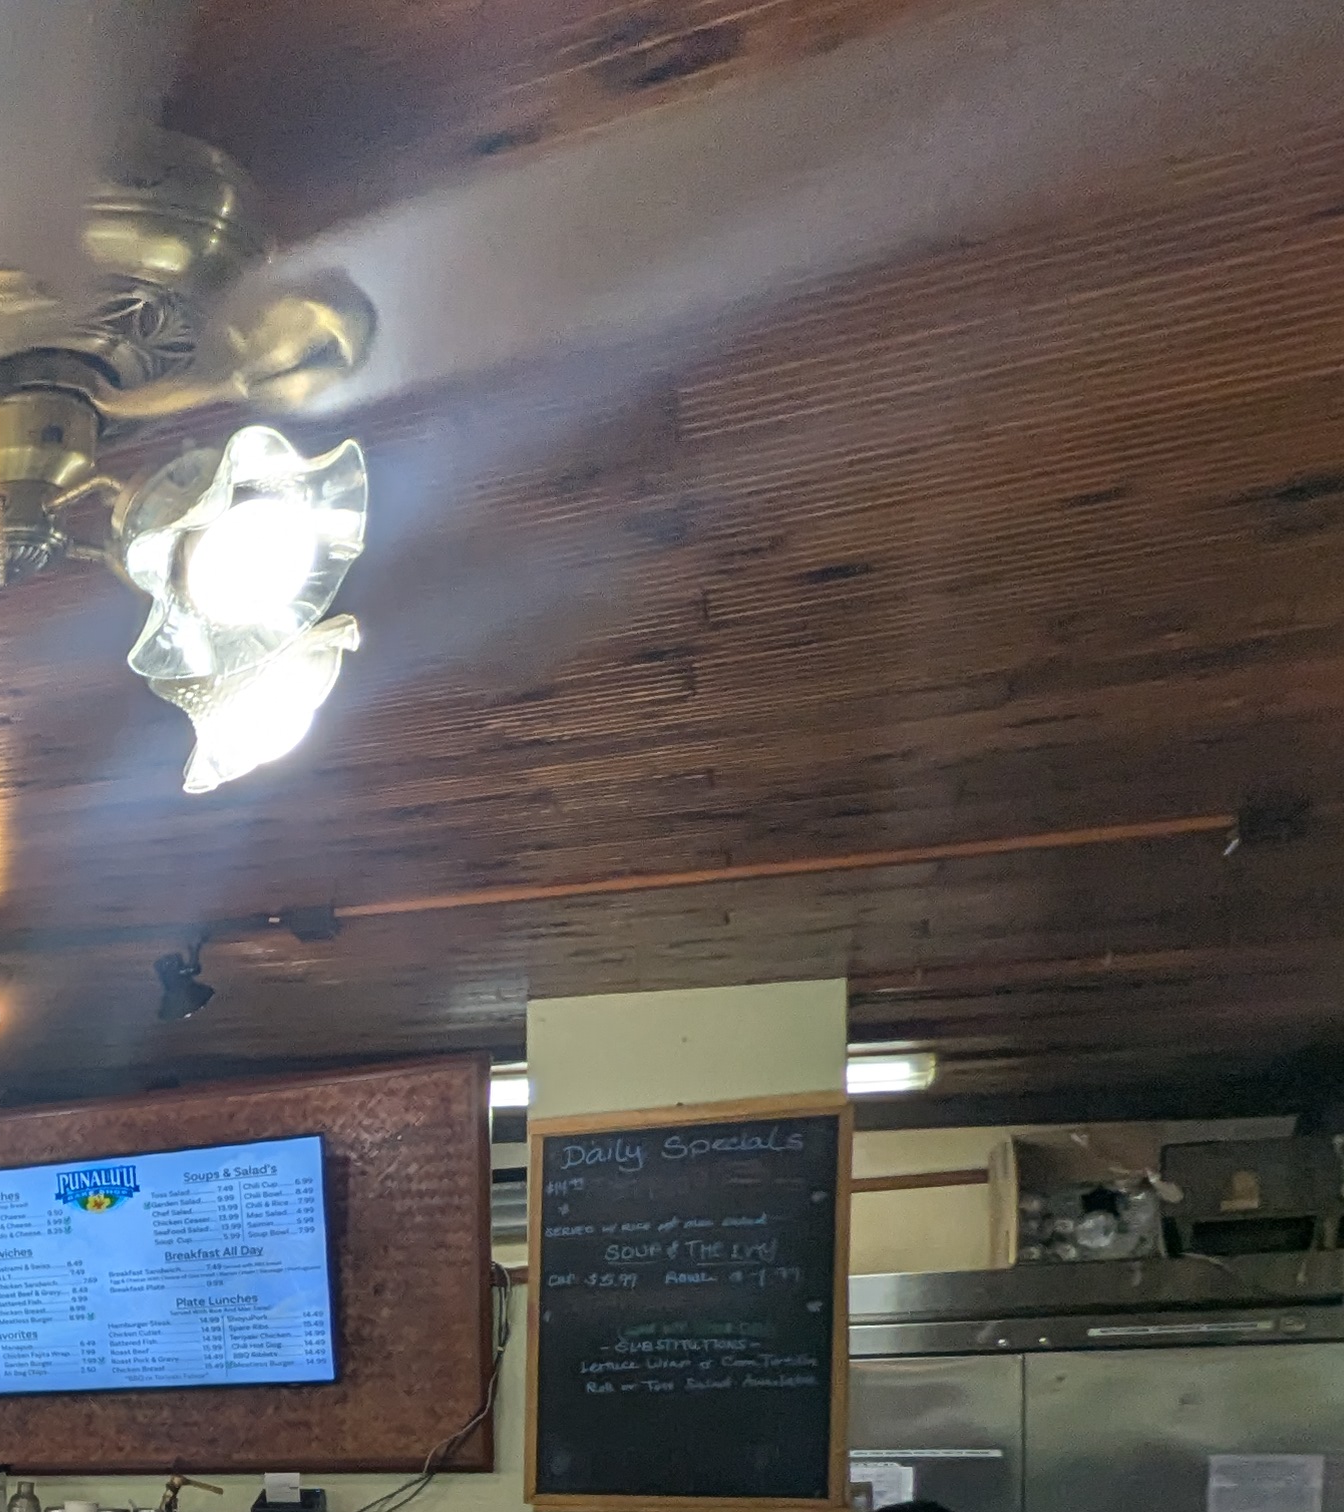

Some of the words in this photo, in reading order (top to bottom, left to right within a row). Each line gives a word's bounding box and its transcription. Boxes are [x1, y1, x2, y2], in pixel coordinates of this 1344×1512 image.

[560, 1138, 643, 1173] Daily
[661, 1126, 803, 1159] Specials
[183, 1171, 220, 1182] Soups
[223, 1168, 231, 1177] &
[233, 1164, 278, 1177] Salad's
[164, 1248, 220, 1261] Breakfast
[223, 1246, 237, 1256] All
[240, 1245, 264, 1257] Day
[176, 1297, 205, 1308] Plate
[208, 1294, 258, 1306] Lunches
